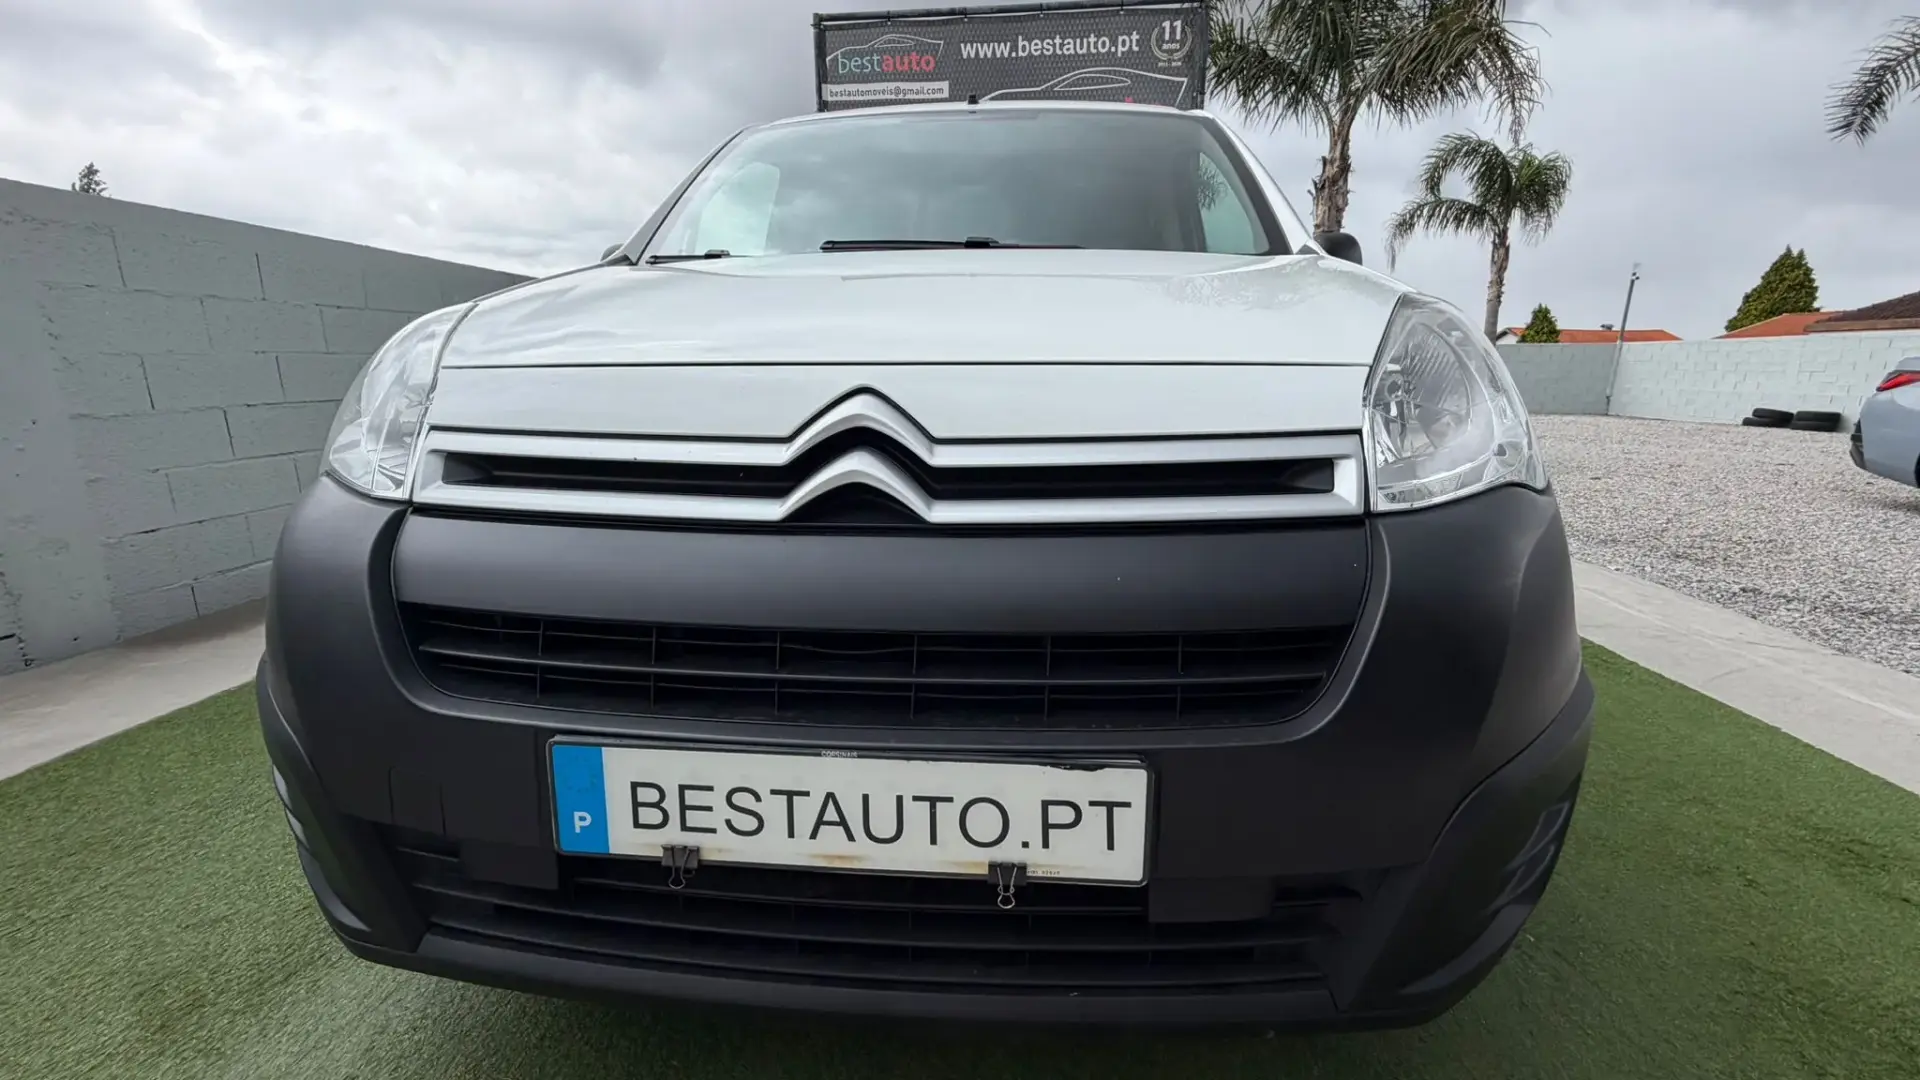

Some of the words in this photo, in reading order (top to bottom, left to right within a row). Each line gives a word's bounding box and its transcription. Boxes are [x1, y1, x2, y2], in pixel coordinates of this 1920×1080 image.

[1162, 20, 1181, 40] 11
[960, 31, 1140, 59] www.bestauto.pt
[838, 51, 936, 73] bestauto
[829, 86, 944, 98] bestautomoveis@gmail.com
[573, 811, 592, 833] P
[630, 781, 1132, 852] BESTAUTO.PT
